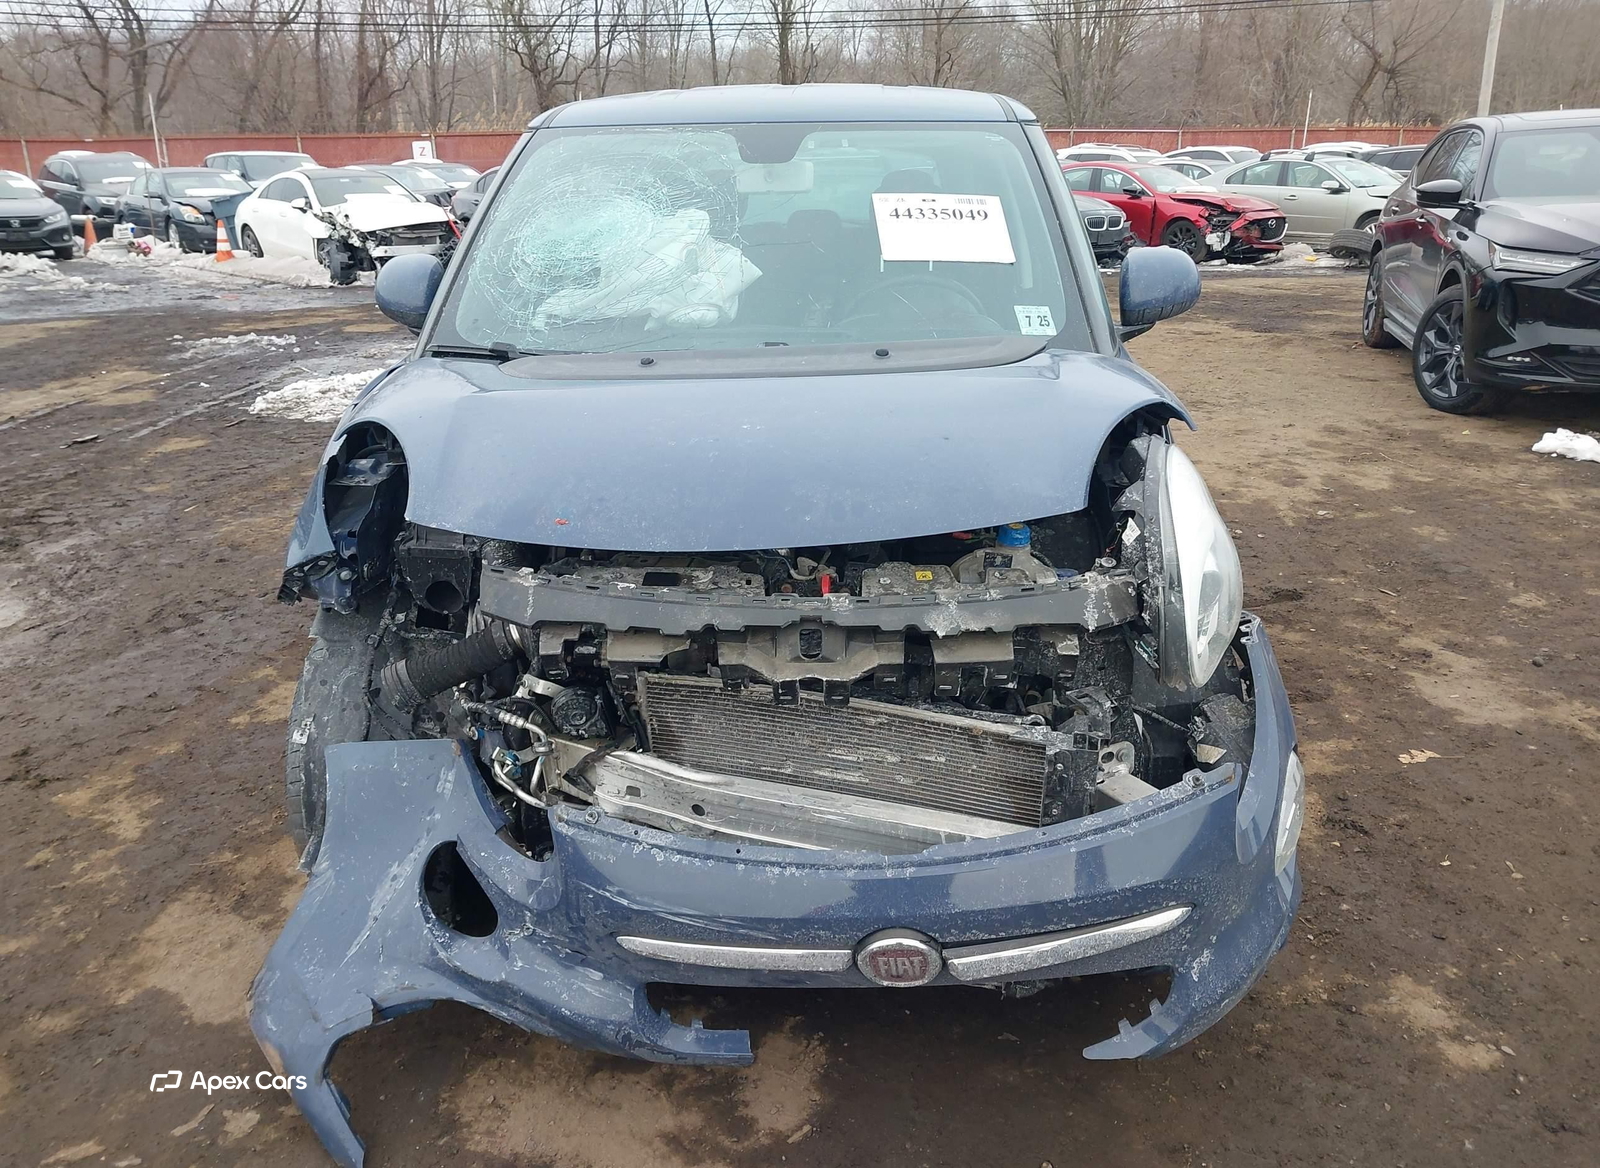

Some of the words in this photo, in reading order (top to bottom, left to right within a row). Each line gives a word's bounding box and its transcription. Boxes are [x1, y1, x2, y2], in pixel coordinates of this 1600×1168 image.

[418, 146, 427, 157] Z
[889, 207, 988, 221] 44335049
[1025, 315, 1031, 327] 7
[1036, 315, 1050, 327] 25
[877, 955, 924, 978] FIAT
